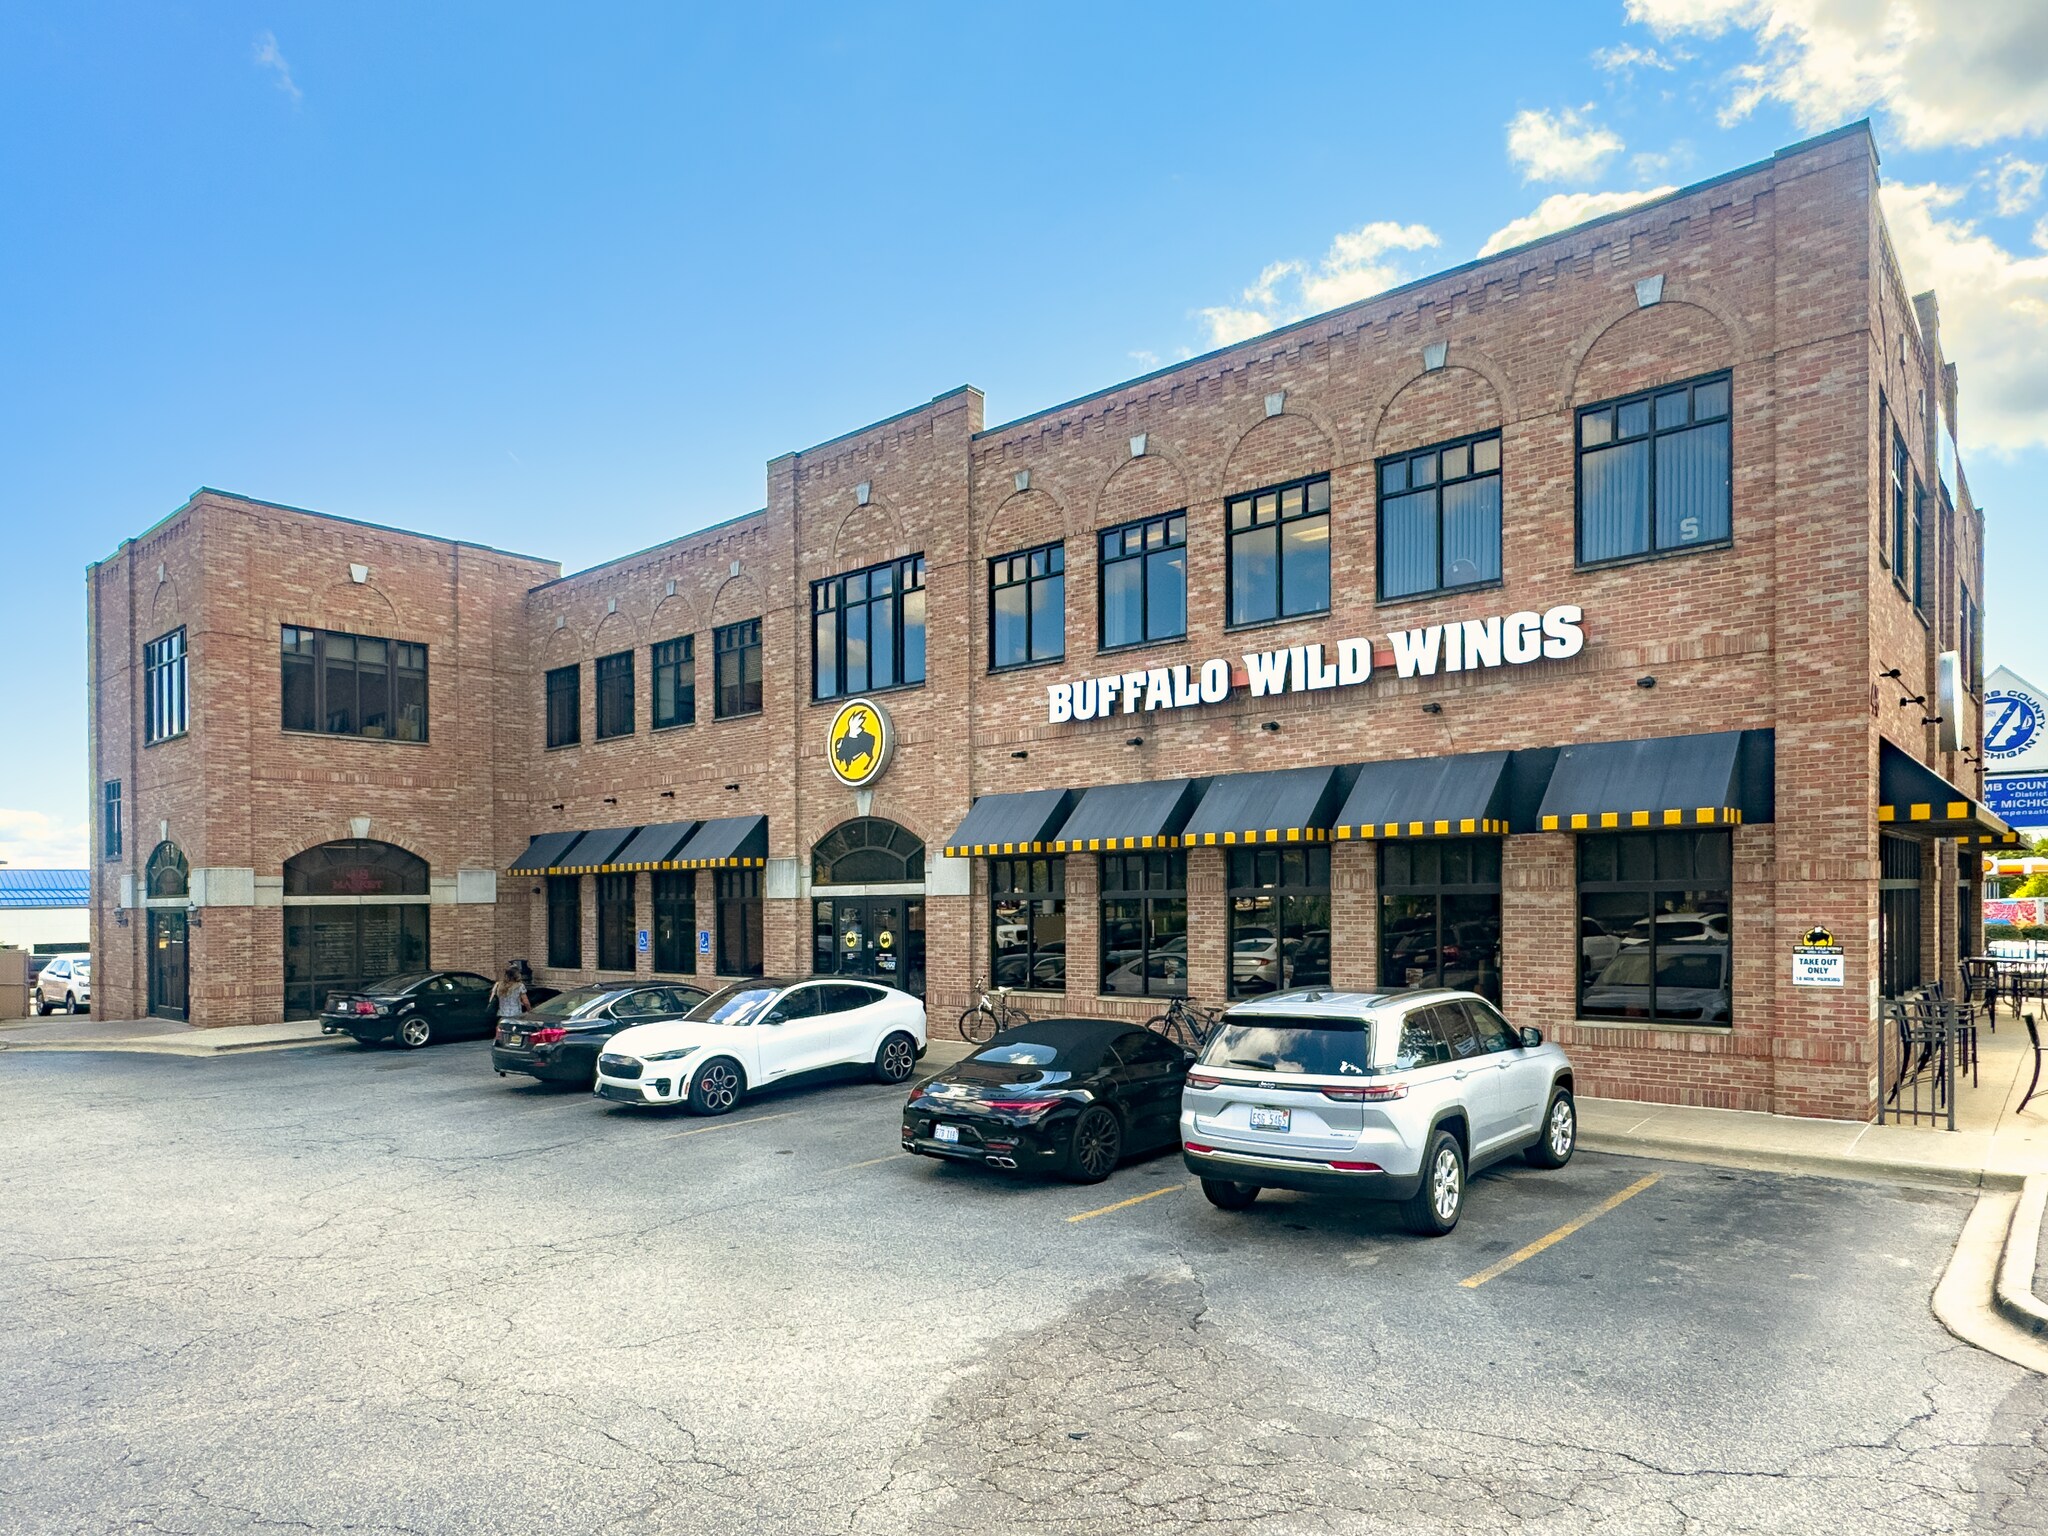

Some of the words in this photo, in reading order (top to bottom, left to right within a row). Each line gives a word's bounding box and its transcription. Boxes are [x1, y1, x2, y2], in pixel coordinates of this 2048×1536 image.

[1047, 659, 1230, 724] BUFFALO
[1242, 637, 1372, 697] WILD
[1387, 605, 1584, 679] WINGS
[2007, 690, 2045, 729] COUNTY
[2001, 799, 2048, 809] MICHIG
